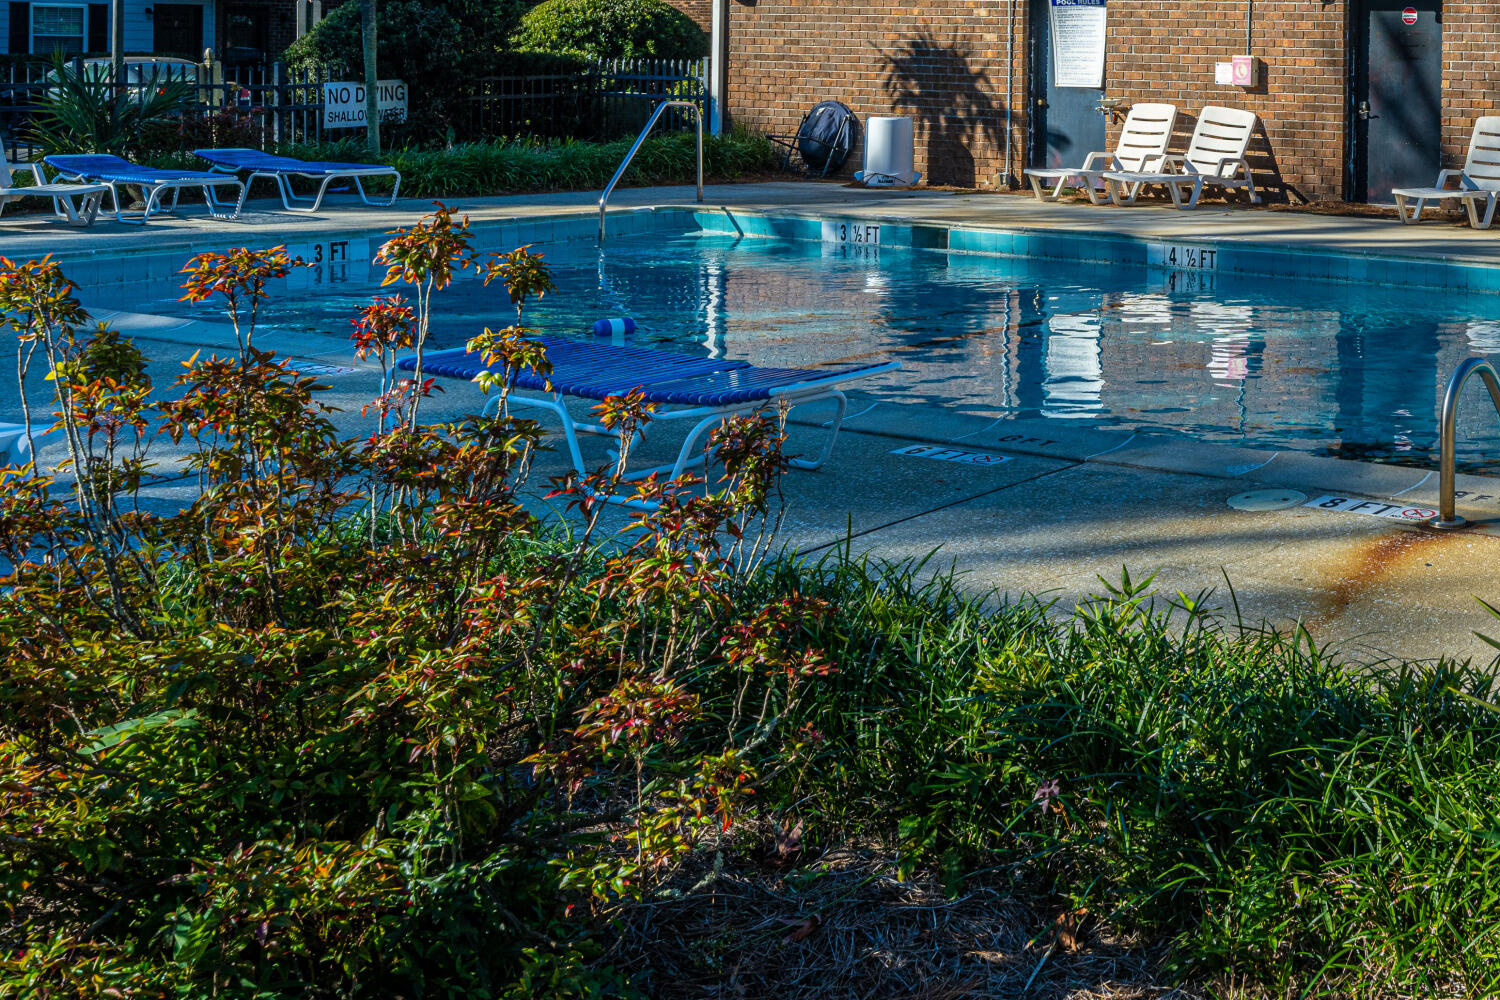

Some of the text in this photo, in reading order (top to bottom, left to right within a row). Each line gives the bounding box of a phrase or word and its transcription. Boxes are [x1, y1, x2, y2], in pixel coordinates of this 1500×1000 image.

[328, 85, 405, 104] NO DING
[328, 109, 368, 123] SHALLO
[840, 224, 847, 241] 3
[866, 226, 879, 243] FT
[314, 240, 349, 263] 3 FT
[1169, 247, 1177, 266] 4
[1200, 249, 1216, 268] FT
[904, 446, 977, 460] 6 FT
[1319, 498, 1402, 515] 8 FT
